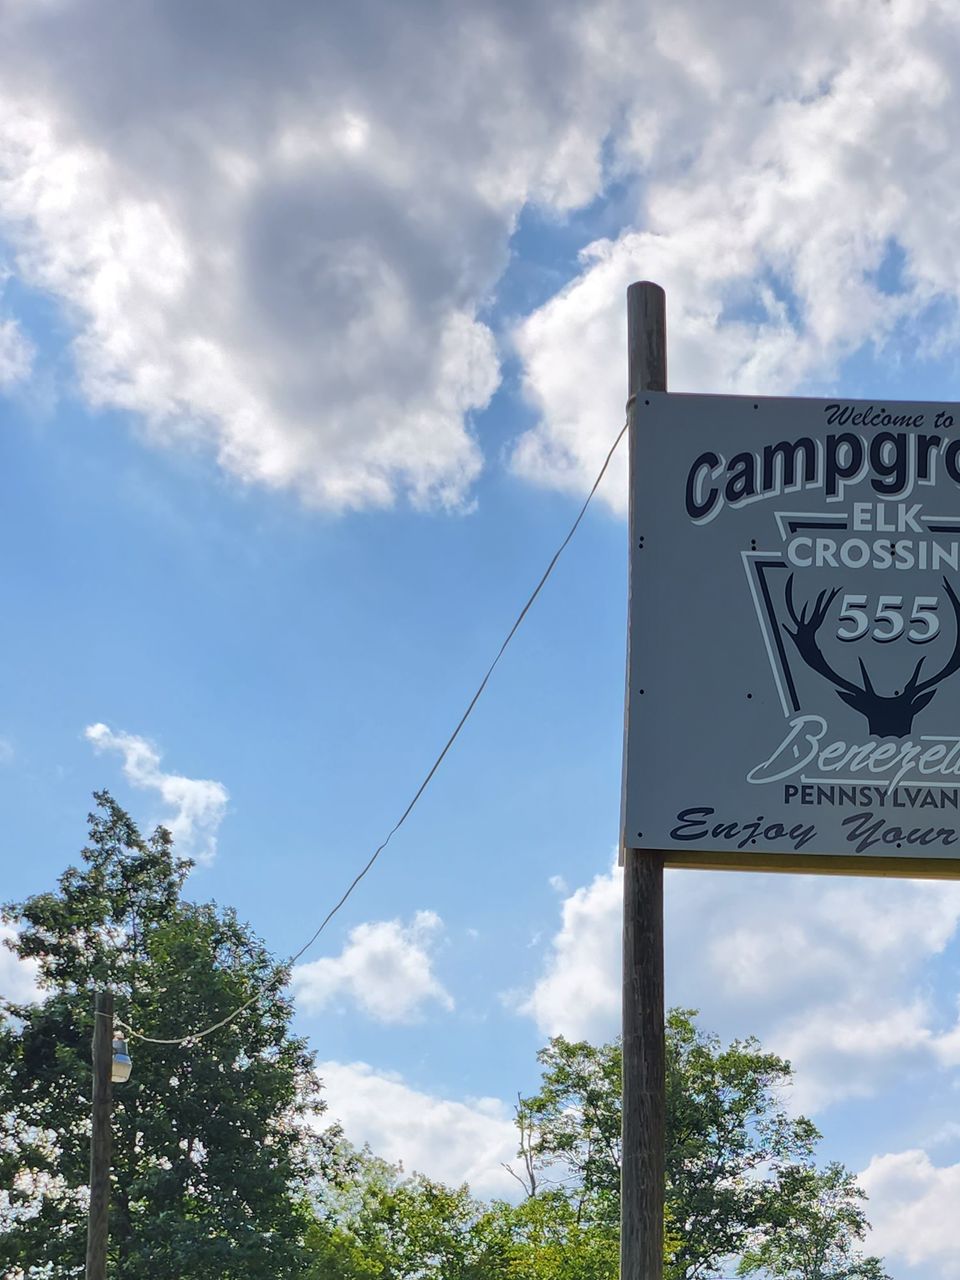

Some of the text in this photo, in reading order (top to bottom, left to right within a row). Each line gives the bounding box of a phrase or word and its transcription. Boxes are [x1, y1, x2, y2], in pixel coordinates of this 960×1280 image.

[824, 404, 955, 430] Welcome to
[853, 502, 924, 533] ELK
[836, 594, 941, 644] 555
[669, 807, 817, 846] Enjoy
[841, 812, 959, 853] Your
